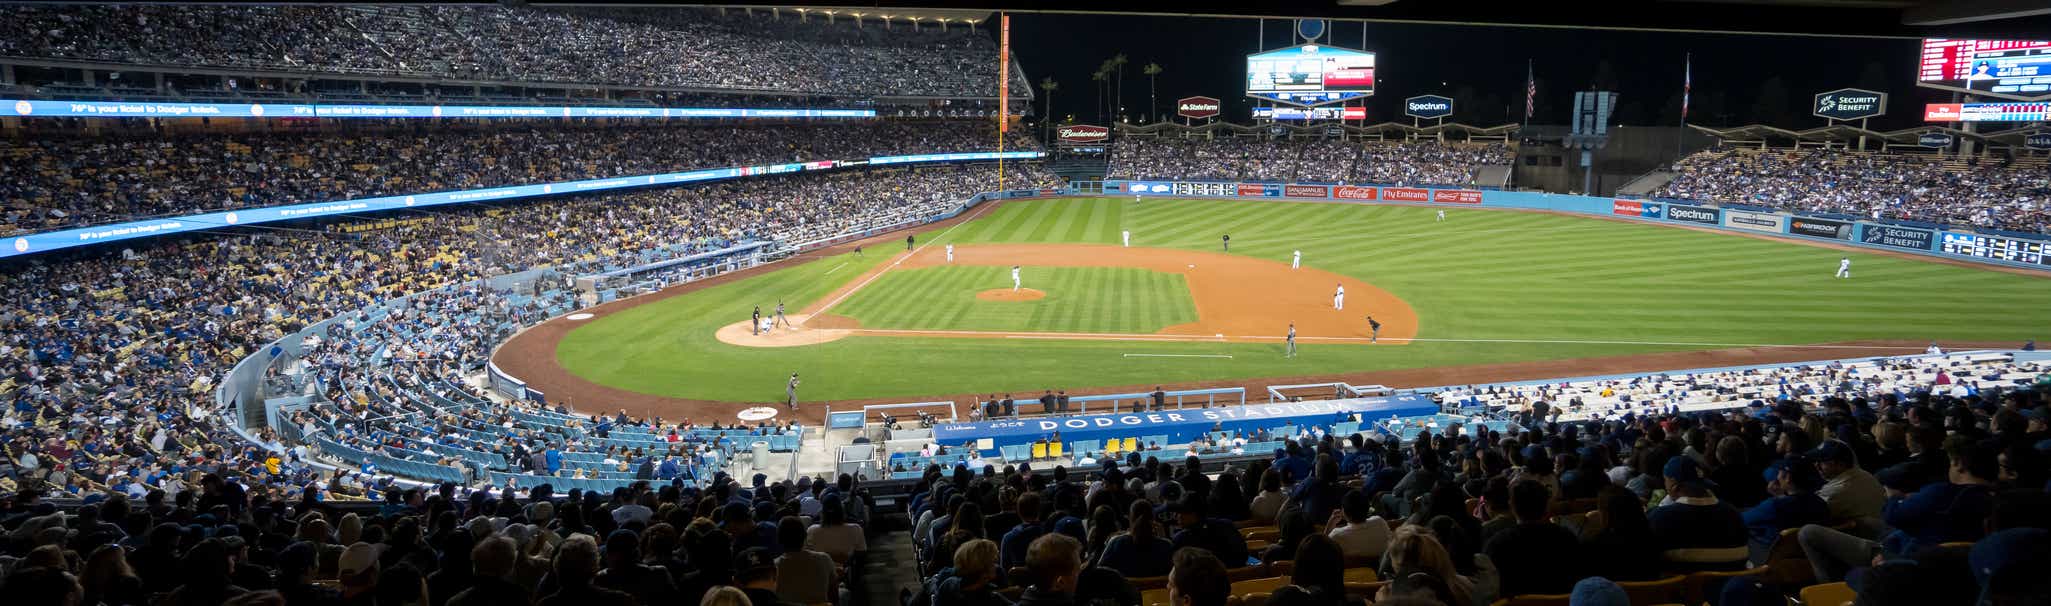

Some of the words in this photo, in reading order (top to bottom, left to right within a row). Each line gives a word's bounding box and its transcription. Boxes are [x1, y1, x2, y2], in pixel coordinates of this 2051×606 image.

[1838, 96, 1877, 104] SECURITY
[1409, 102, 1446, 111] Spectrum
[1060, 128, 1106, 138] Budweiser
[1383, 190, 1396, 199] Fly
[1396, 190, 1428, 199] Emirates
[1670, 207, 1714, 221] Spectrum
[1884, 228, 1928, 240] SECURITY
[1883, 236, 1921, 248] BENEFIT
[1039, 412, 1187, 430] DODGER
[1202, 401, 1344, 420] STADIUM
